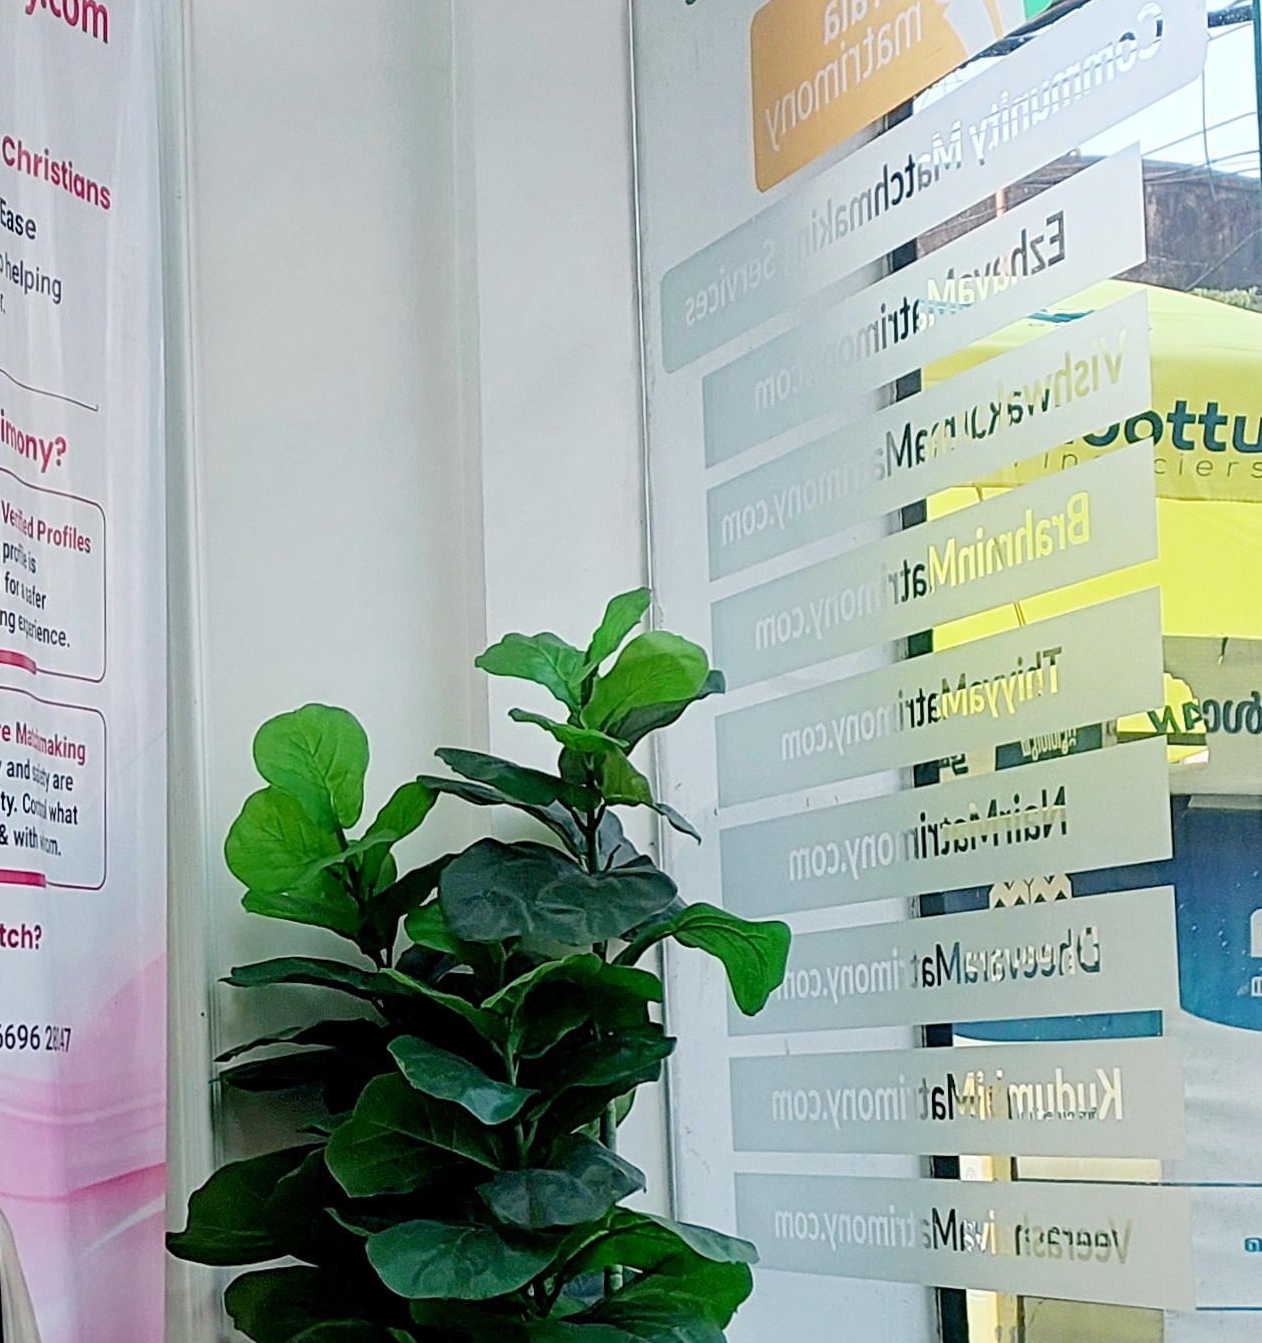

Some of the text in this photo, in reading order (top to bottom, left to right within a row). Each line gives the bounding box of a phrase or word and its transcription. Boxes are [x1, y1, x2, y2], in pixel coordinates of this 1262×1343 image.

[2, 135, 112, 210] Christians
[0, 197, 37, 241] Ease
[4, 251, 62, 305] helping
[37, 519, 92, 554] Profiles
[27, 551, 37, 573] is
[4, 571, 20, 595] for
[15, 721, 86, 766] Mamaking
[6, 758, 31, 781] and
[52, 771, 74, 792] are
[49, 800, 78, 826] what
[13, 826, 39, 850] with
[45, 1024, 72, 1053] 247
